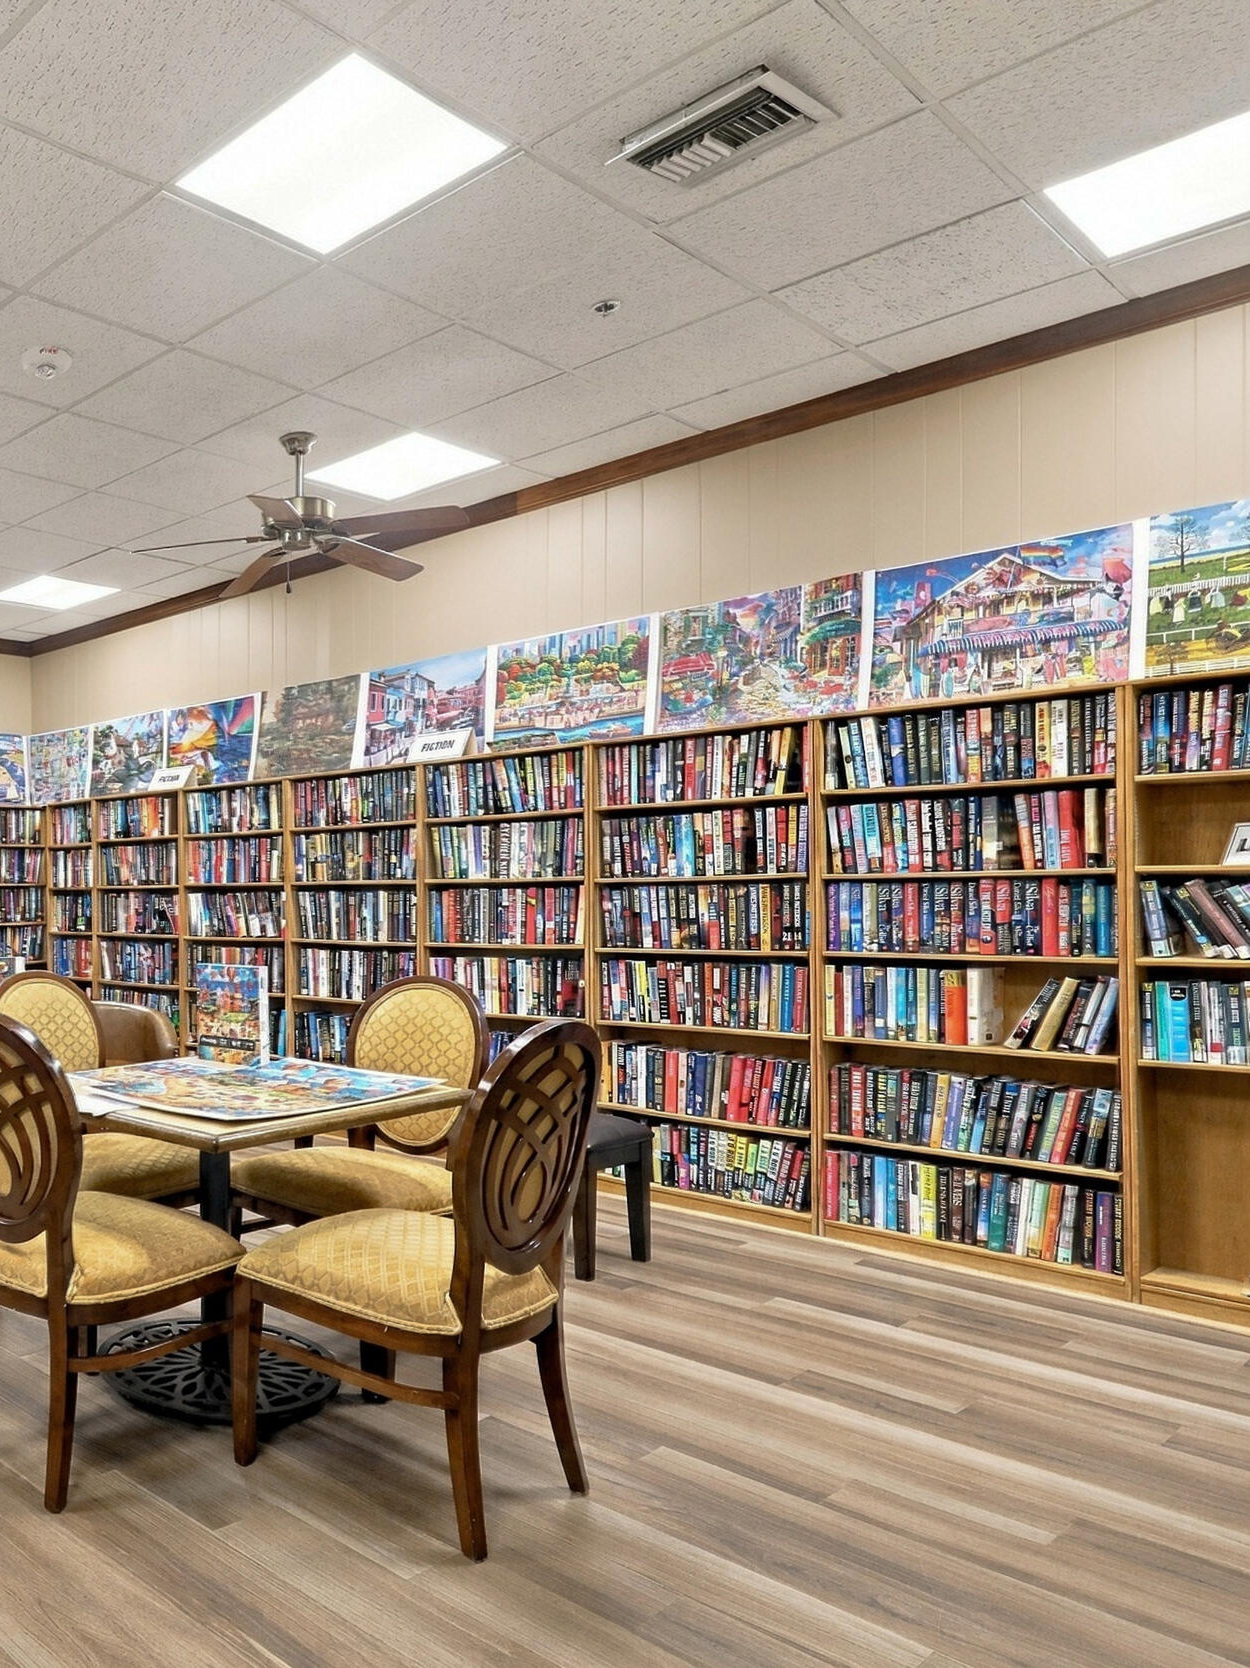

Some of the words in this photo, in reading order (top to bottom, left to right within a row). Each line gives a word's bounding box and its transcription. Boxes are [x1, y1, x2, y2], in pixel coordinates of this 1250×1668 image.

[421, 739, 456, 752] FICTION
[878, 888, 890, 911] Silva
[892, 888, 902, 908] Silva
[934, 887, 948, 912] Silva
[950, 887, 963, 911] Silva
[968, 901, 976, 916] Silva
[996, 886, 1009, 911] Silva
[1025, 886, 1039, 910] Silva
[782, 932, 792, 941] 21
[877, 1090, 886, 1112] TAYLOR
[1085, 1192, 1093, 1214] STUART
